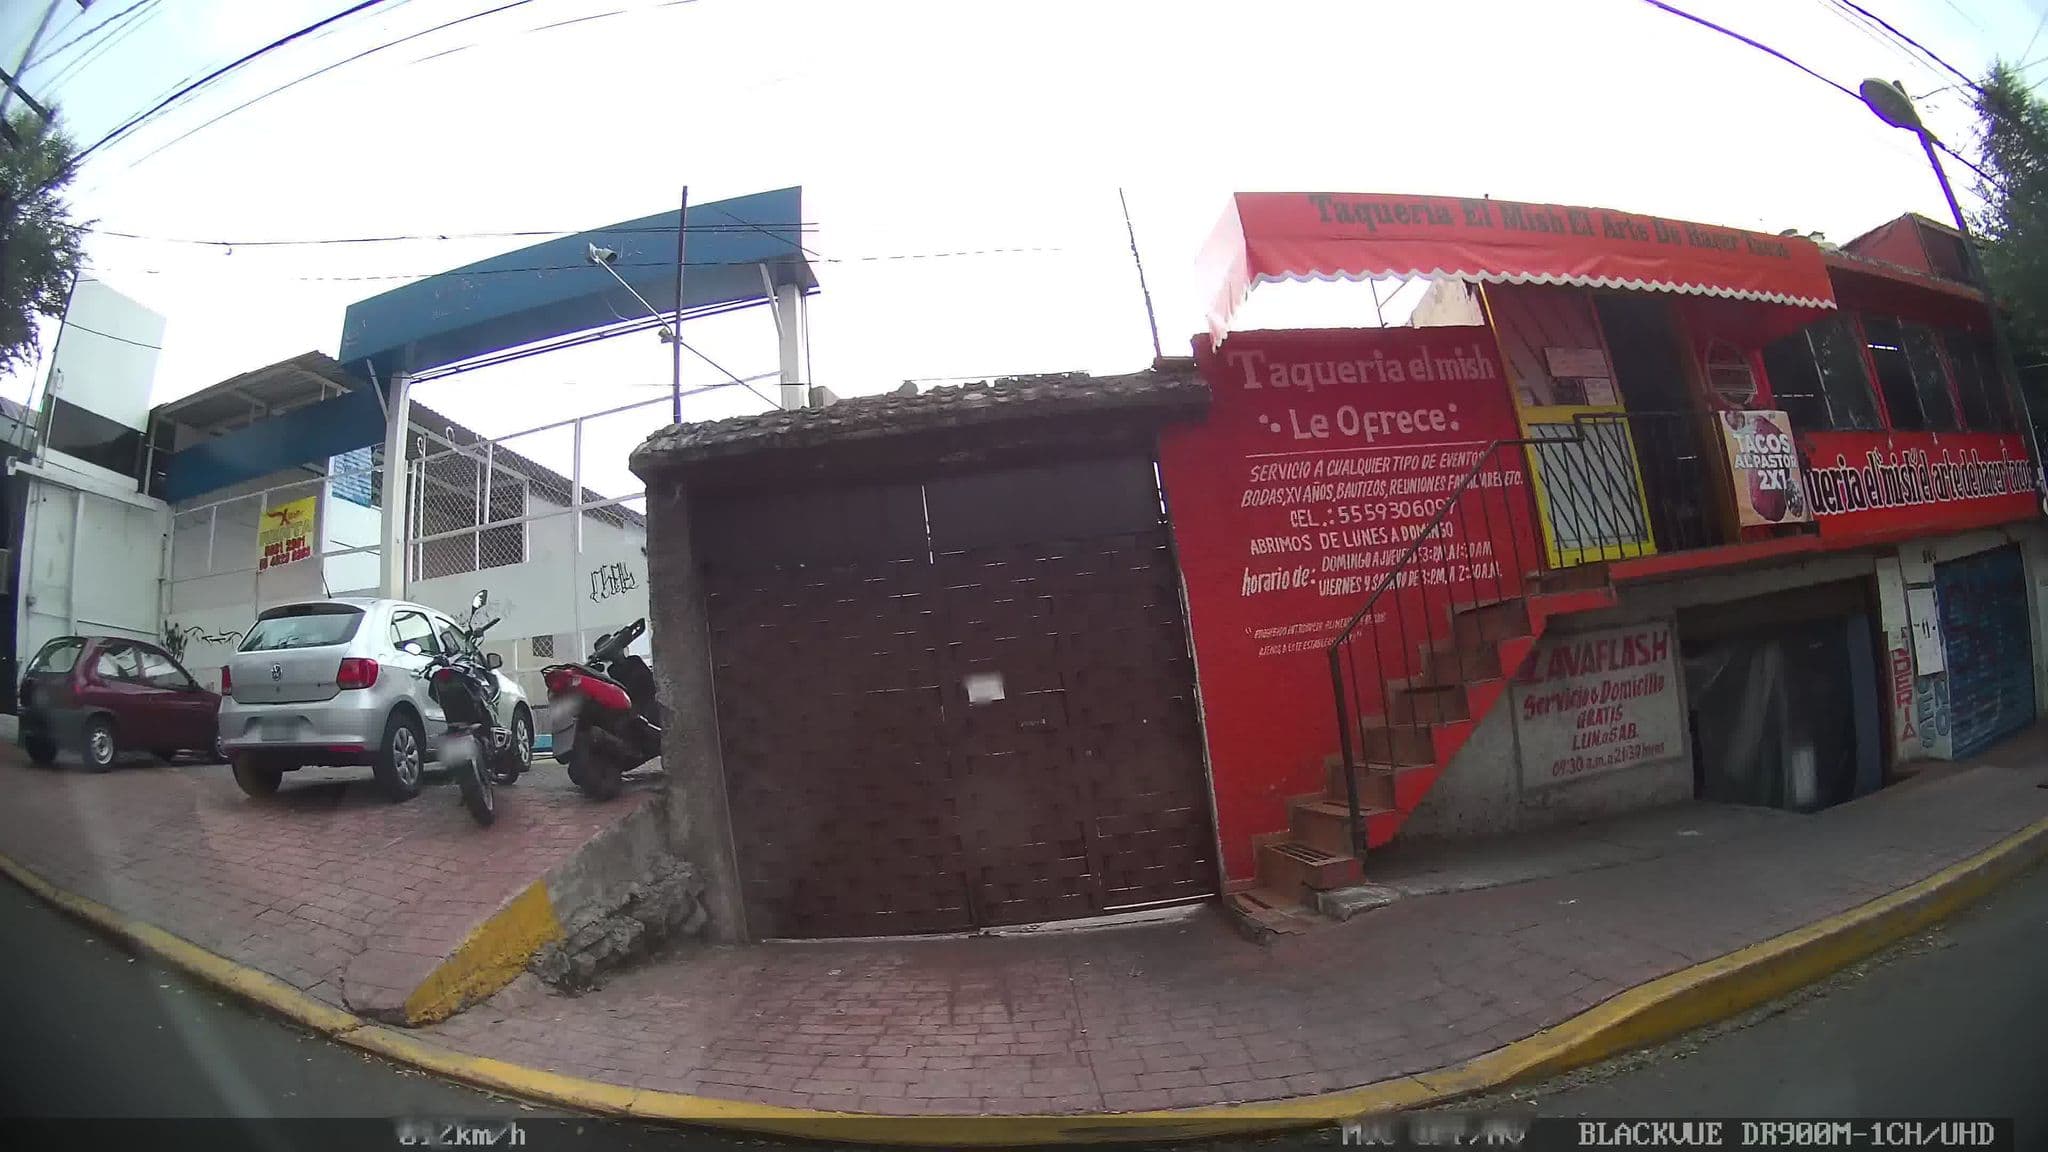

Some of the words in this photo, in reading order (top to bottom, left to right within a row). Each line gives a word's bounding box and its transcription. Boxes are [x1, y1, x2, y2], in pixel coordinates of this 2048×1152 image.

[1309, 194, 1456, 232] Taqueria
[1461, 198, 1494, 228] El
[1503, 204, 1566, 234] Mish
[1568, 208, 1594, 236] El
[1228, 349, 1407, 392] Taqueria
[1409, 345, 1434, 381] el
[1436, 343, 1495, 380] mish
[1289, 408, 1330, 440] Le
[1733, 432, 1791, 453] TACOS
[1251, 460, 1311, 482] SERVICIO
[1314, 462, 1323, 478] A
[1327, 457, 1390, 477] CUALQUIER
[1392, 455, 1419, 472] TIPO
[1421, 453, 1436, 470] DE
[1735, 454, 1755, 469] AL
[1754, 454, 1799, 469] PASTOR
[1390, 475, 1446, 495] REUNIONES
[1448, 471, 1502, 491] FAMLARE
[1758, 469, 1788, 490] 2X1
[1802, 454, 1867, 516] ueria
[1250, 534, 1312, 556] ABRIMOS
[1320, 532, 1340, 550] DE
[1344, 526, 1388, 548] LUNES
[1391, 527, 1400, 544] A
[1400, 520, 1453, 541] DOMNGO
[1321, 552, 1372, 572] DOMINGO
[1372, 551, 1380, 567] A
[1380, 547, 1412, 566] JUEVE
[1242, 567, 1289, 597] horario
[1319, 576, 1362, 596] VIERNES
[1372, 571, 1407, 592] SAADO
[1408, 569, 1419, 587] DE
[1517, 630, 1668, 684] LAVAFLASH
[1601, 673, 1665, 705] Domicilio
[1576, 703, 1624, 730] GRATIS
